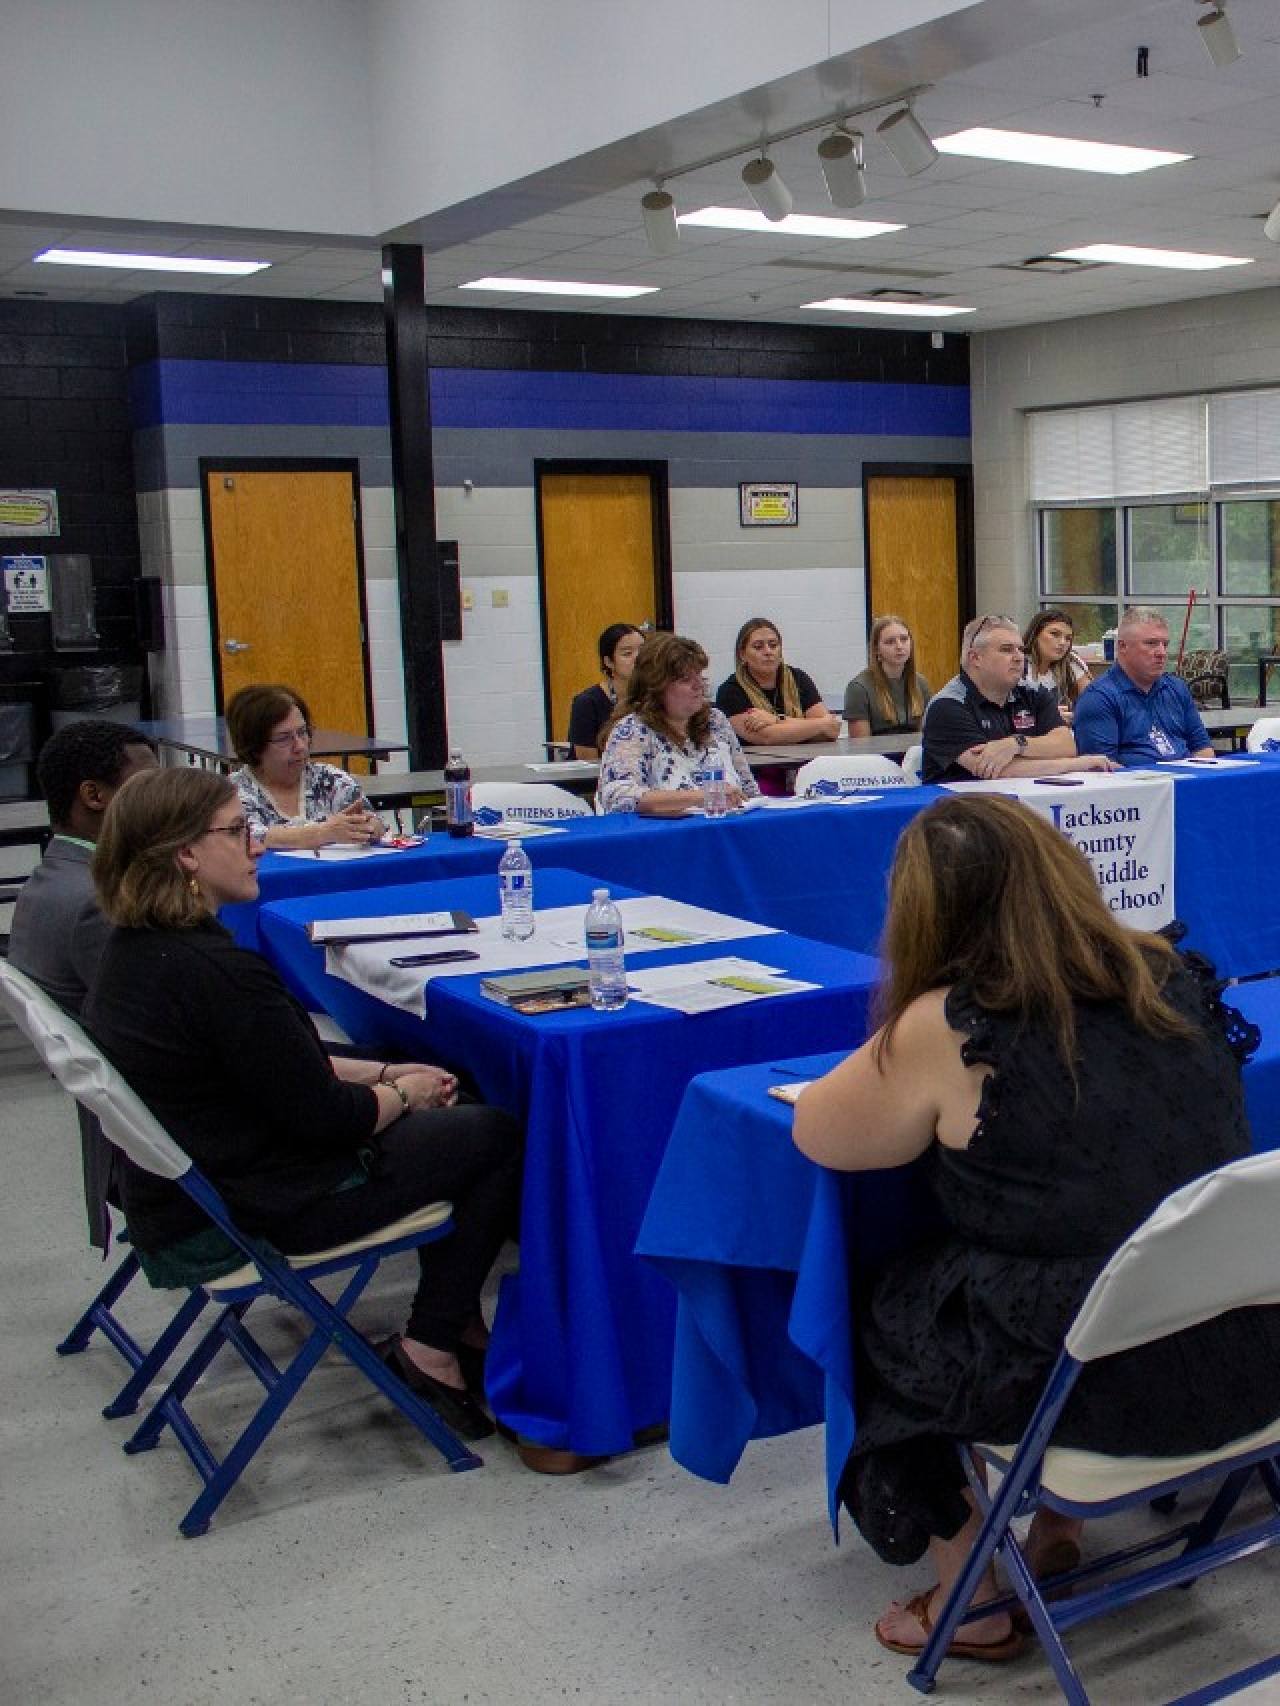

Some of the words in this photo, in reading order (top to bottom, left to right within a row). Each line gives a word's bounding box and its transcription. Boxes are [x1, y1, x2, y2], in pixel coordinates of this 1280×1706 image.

[506, 807, 555, 819] CITIZENS
[1064, 832, 1137, 857] ounty
[1093, 858, 1149, 885] iddle
[1106, 883, 1165, 911] chool
